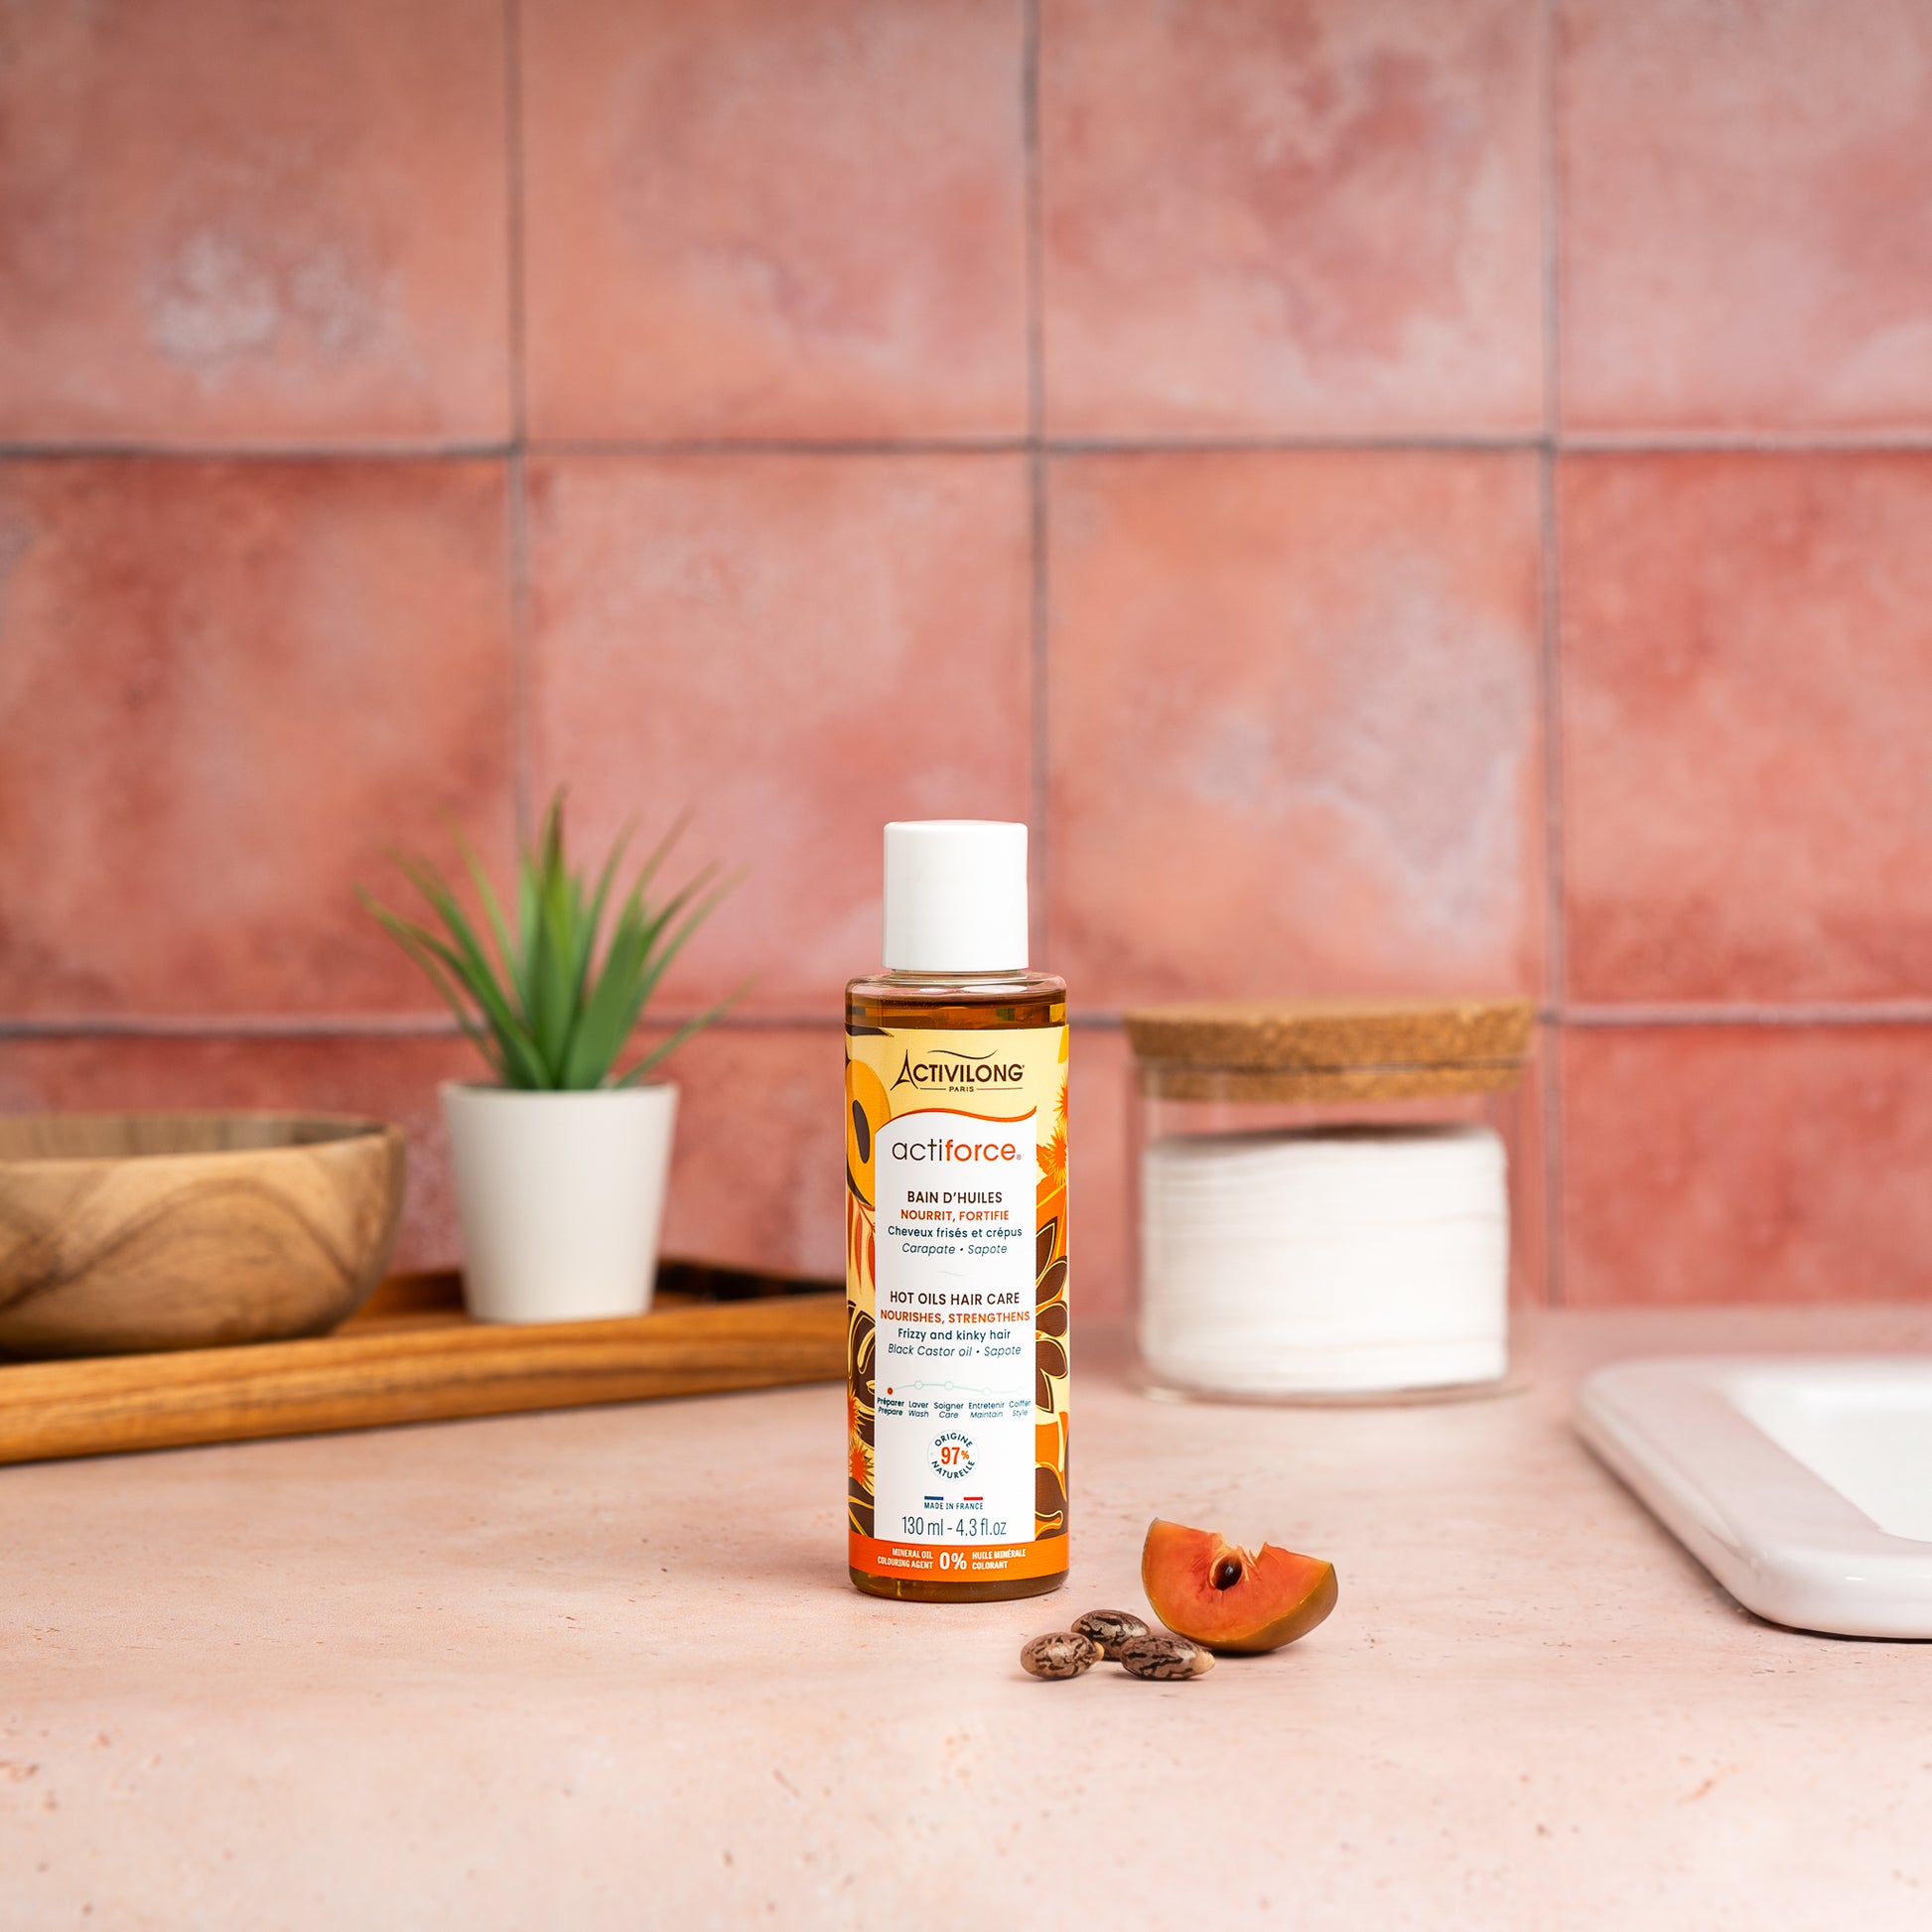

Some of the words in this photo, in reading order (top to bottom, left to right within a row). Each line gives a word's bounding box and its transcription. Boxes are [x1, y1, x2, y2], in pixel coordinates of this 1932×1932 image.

[891, 1049, 1023, 1091] ACTIVILONG
[907, 1191, 938, 1202] BAIN
[943, 1191, 1002, 1203] D’HUILES
[900, 1209, 955, 1222] NOURRIT,
[959, 1210, 1009, 1220] FORTIFIE
[888, 1226, 932, 1237] Cheveux
[937, 1228, 967, 1237] frisés
[986, 1227, 1022, 1239] crépus
[902, 1243, 955, 1256] Carapate
[968, 1245, 1007, 1256] Sapote
[891, 1291, 913, 1304] HOT
[918, 1294, 946, 1305] OILS
[951, 1294, 982, 1305] HAIR
[987, 1293, 1020, 1305] CARE
[881, 1310, 944, 1324] NOURISHES,
[949, 1311, 1030, 1323] STRENGTHENS
[898, 1328, 926, 1342] Frizzy
[930, 1330, 952, 1339] and
[957, 1330, 986, 1342] kinky
[991, 1329, 1011, 1339] hair
[889, 1344, 913, 1355] Black
[917, 1346, 954, 1356] Castor
[959, 1347, 972, 1356] oil
[985, 1346, 1021, 1358] Sapote
[878, 1398, 904, 1407] Préparer
[934, 1402, 963, 1411] Soigner
[879, 1407, 902, 1416] Prepare
[935, 1433, 973, 1448] ORIGINE
[941, 1447, 969, 1464] 97%
[931, 1460, 975, 1479] NATURELLE
[902, 1516, 924, 1535] 130
[927, 1518, 943, 1536] ml
[956, 1518, 977, 1536] 4.3
[981, 1518, 1007, 1535] fl.oz
[893, 1548, 919, 1558] MINERAL
[972, 1551, 993, 1560] HUILE
[994, 1549, 1026, 1559] MINÉRALE
[878, 1556, 909, 1567] COLOURING
[939, 1552, 967, 1570] 0%
[972, 1561, 1008, 1570] COLORANT
